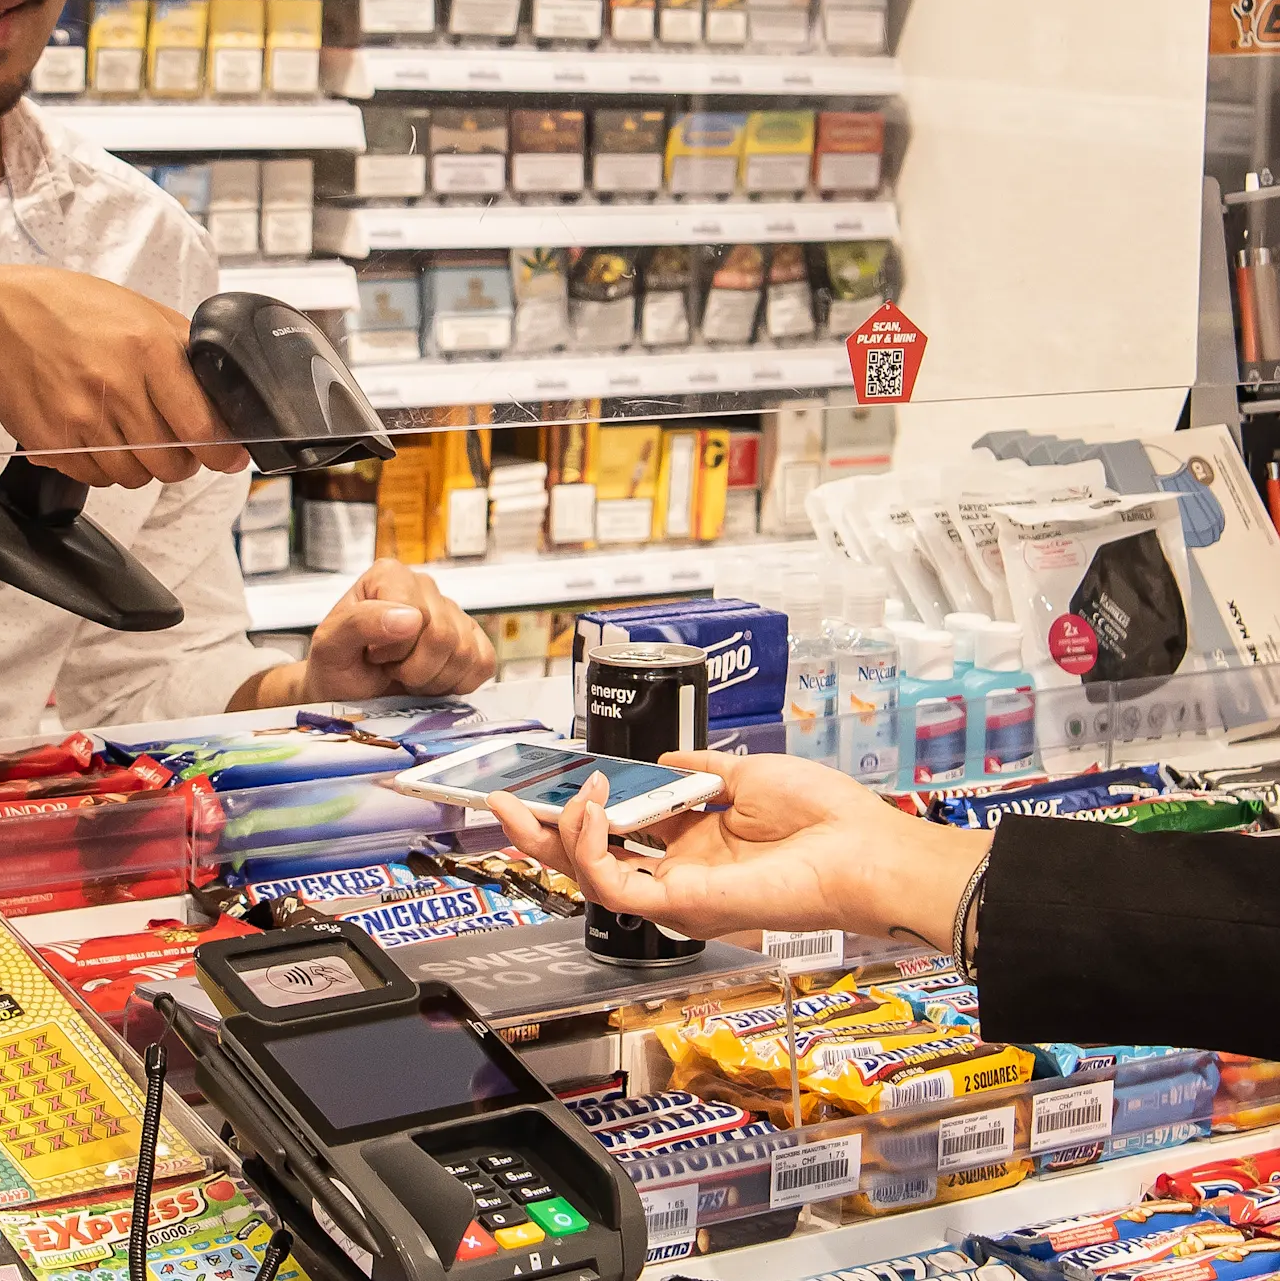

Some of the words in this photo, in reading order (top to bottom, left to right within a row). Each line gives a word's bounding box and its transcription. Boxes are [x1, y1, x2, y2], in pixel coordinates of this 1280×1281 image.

[872, 322, 901, 332] SCAN,
[857, 334, 882, 344] PLAY
[884, 335, 891, 343] &
[893, 333, 916, 343] WIN!
[1063, 622, 1079, 637] 2x
[799, 672, 837, 691] Nexcare
[591, 683, 636, 704] energy
[591, 701, 623, 719] drink
[254, 868, 385, 901] SNICKERS
[338, 892, 478, 935] SNICKERS
[588, 926, 609, 940] 250ml
[126, 953, 145, 961] BALLS
[146, 950, 163, 958] ROLL
[419, 937, 586, 976] SWEE
[452, 971, 542, 990] TO
[904, 1048, 941, 1066] PEANUT
[964, 1076, 971, 1092] 2
[1059, 1102, 1073, 1111] CHF
[1084, 1098, 1099, 1106] 1.95
[963, 1124, 977, 1134] CHF
[988, 1120, 1001, 1129] 1.65
[775, 1148, 800, 1161] SNICKERS
[801, 1142, 841, 1156] PEANUTBUTTER
[801, 1155, 817, 1166] CHF
[828, 1150, 845, 1159] 1.75
[488, 1156, 499, 1166] 3
[506, 1172, 517, 1182] 6
[948, 1173, 955, 1187] 2
[521, 1187, 532, 1197] 9
[476, 1198, 488, 1208] 8
[488, 1197, 502, 1206] TUV
[667, 1200, 684, 1210] 1.65
[493, 1214, 505, 1223] 0
[41, 1250, 75, 1267] LUCKY
[76, 1245, 106, 1262] LINES
